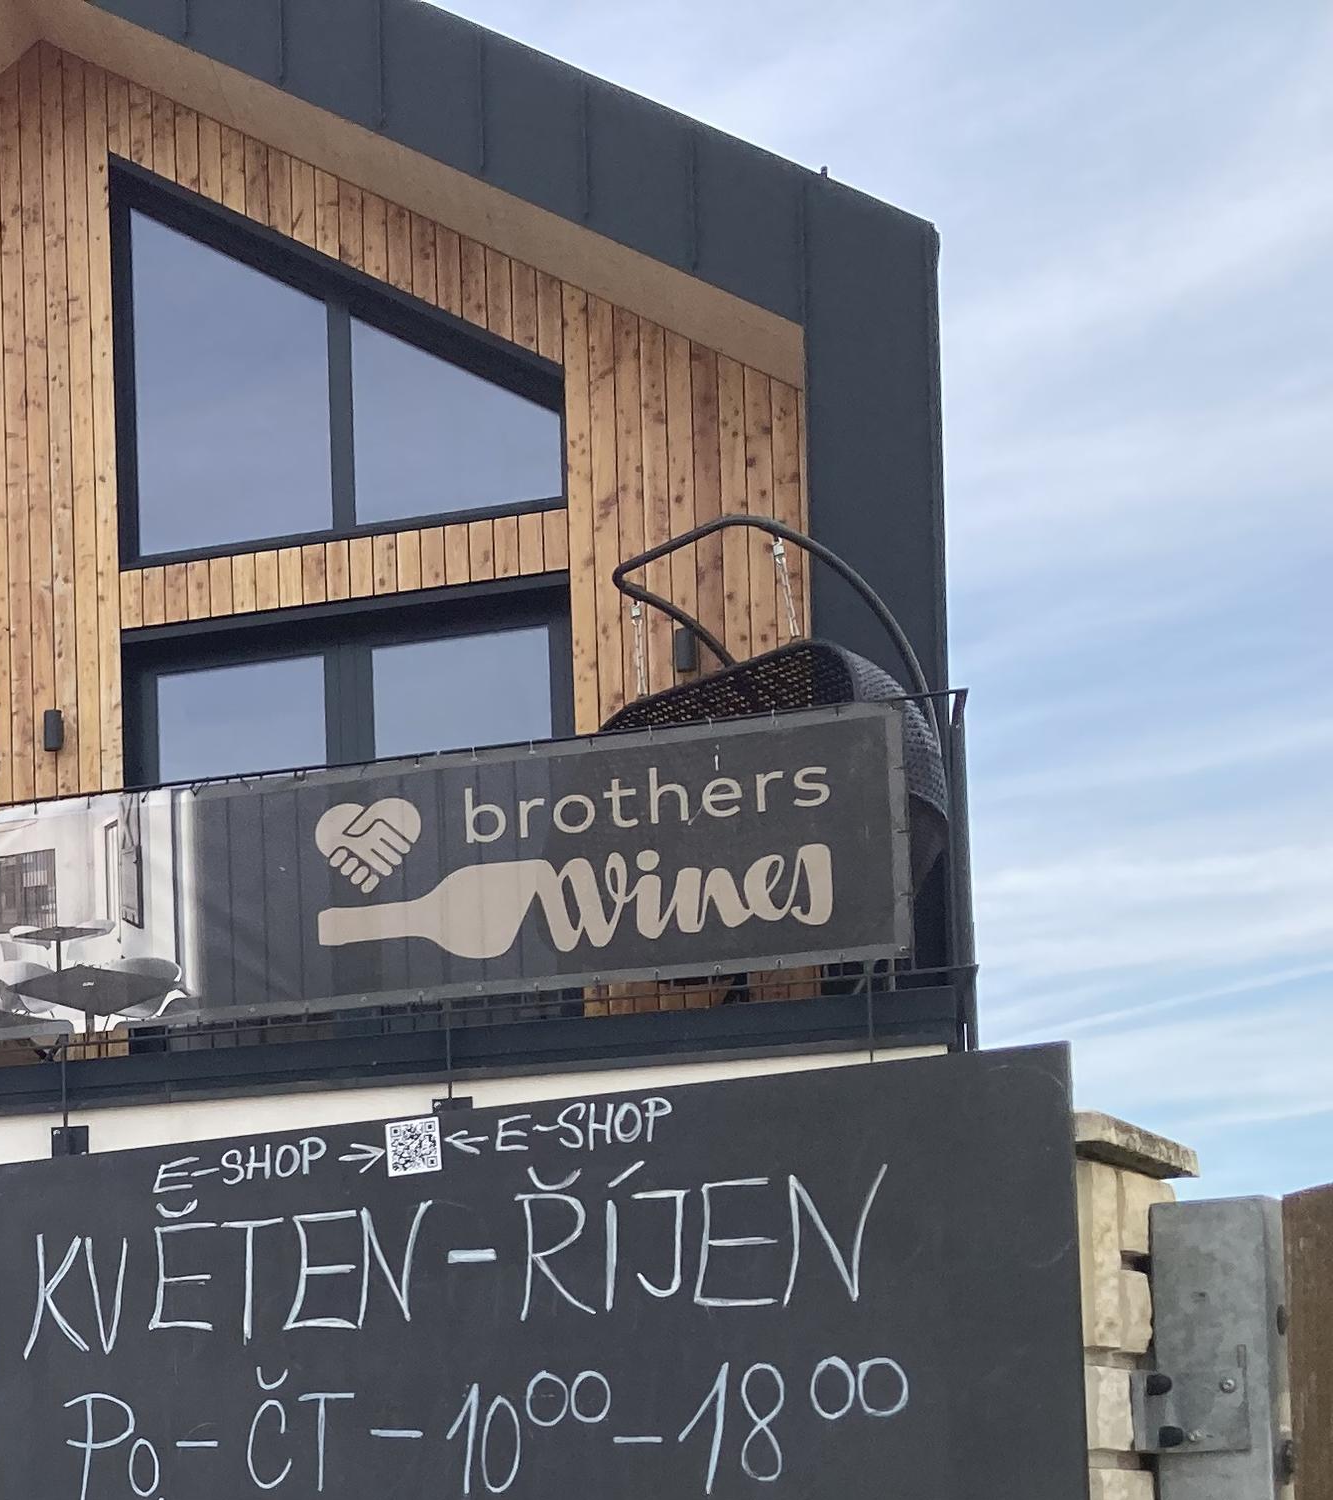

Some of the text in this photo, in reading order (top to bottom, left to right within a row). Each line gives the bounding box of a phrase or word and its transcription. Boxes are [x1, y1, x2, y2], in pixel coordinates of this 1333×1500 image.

[464, 765, 831, 845] brothers
[494, 1096, 673, 1152] E-SHOP
[153, 1136, 327, 1194] E-SHOP
[23, 1198, 432, 1361] KVĚTEN
[514, 1160, 889, 1322] ŘÍJEN
[246, 1366, 355, 1492] ČT
